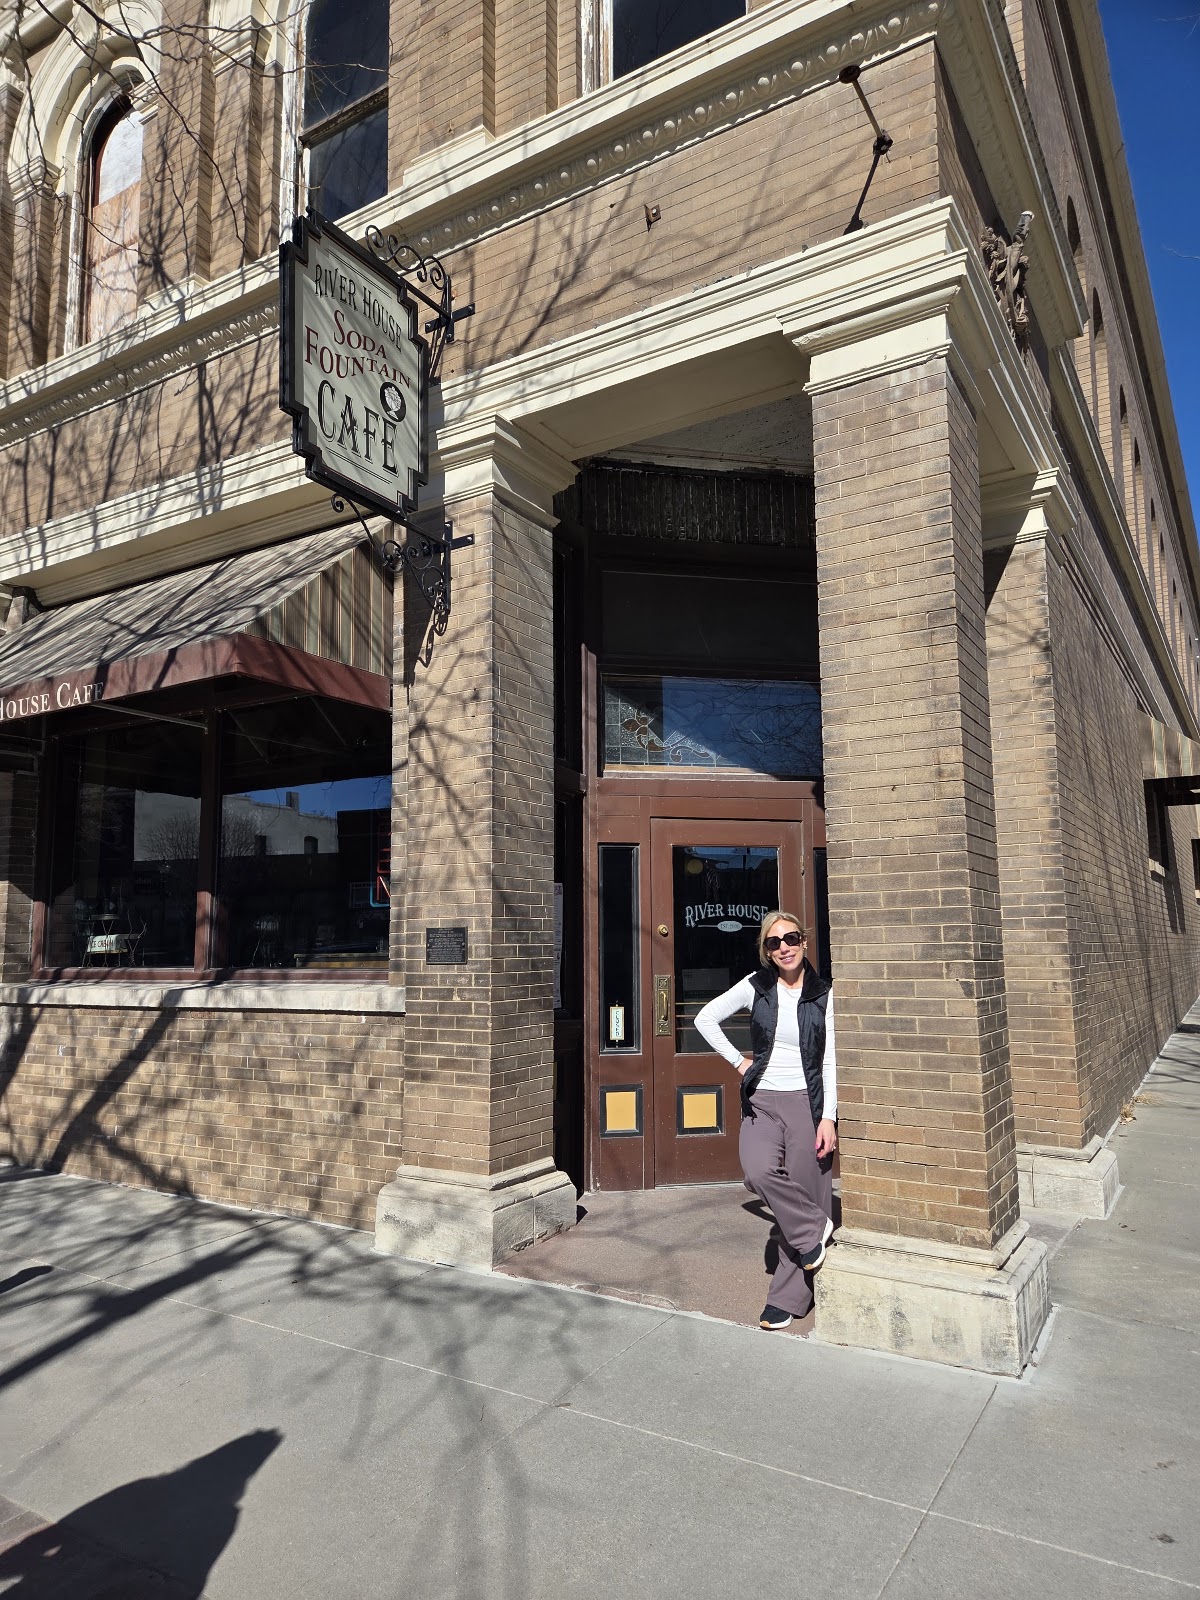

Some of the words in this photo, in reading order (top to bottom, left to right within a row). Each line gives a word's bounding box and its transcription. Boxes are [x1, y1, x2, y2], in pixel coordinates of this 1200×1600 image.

[314, 263, 358, 311] RIVER
[362, 285, 402, 353] HOUSE
[333, 309, 387, 360] SODA
[304, 325, 411, 388] FOUNTAIN
[317, 379, 399, 478] CAFE
[56, 682, 104, 708] CAFE
[685, 902, 725, 928] RIVER
